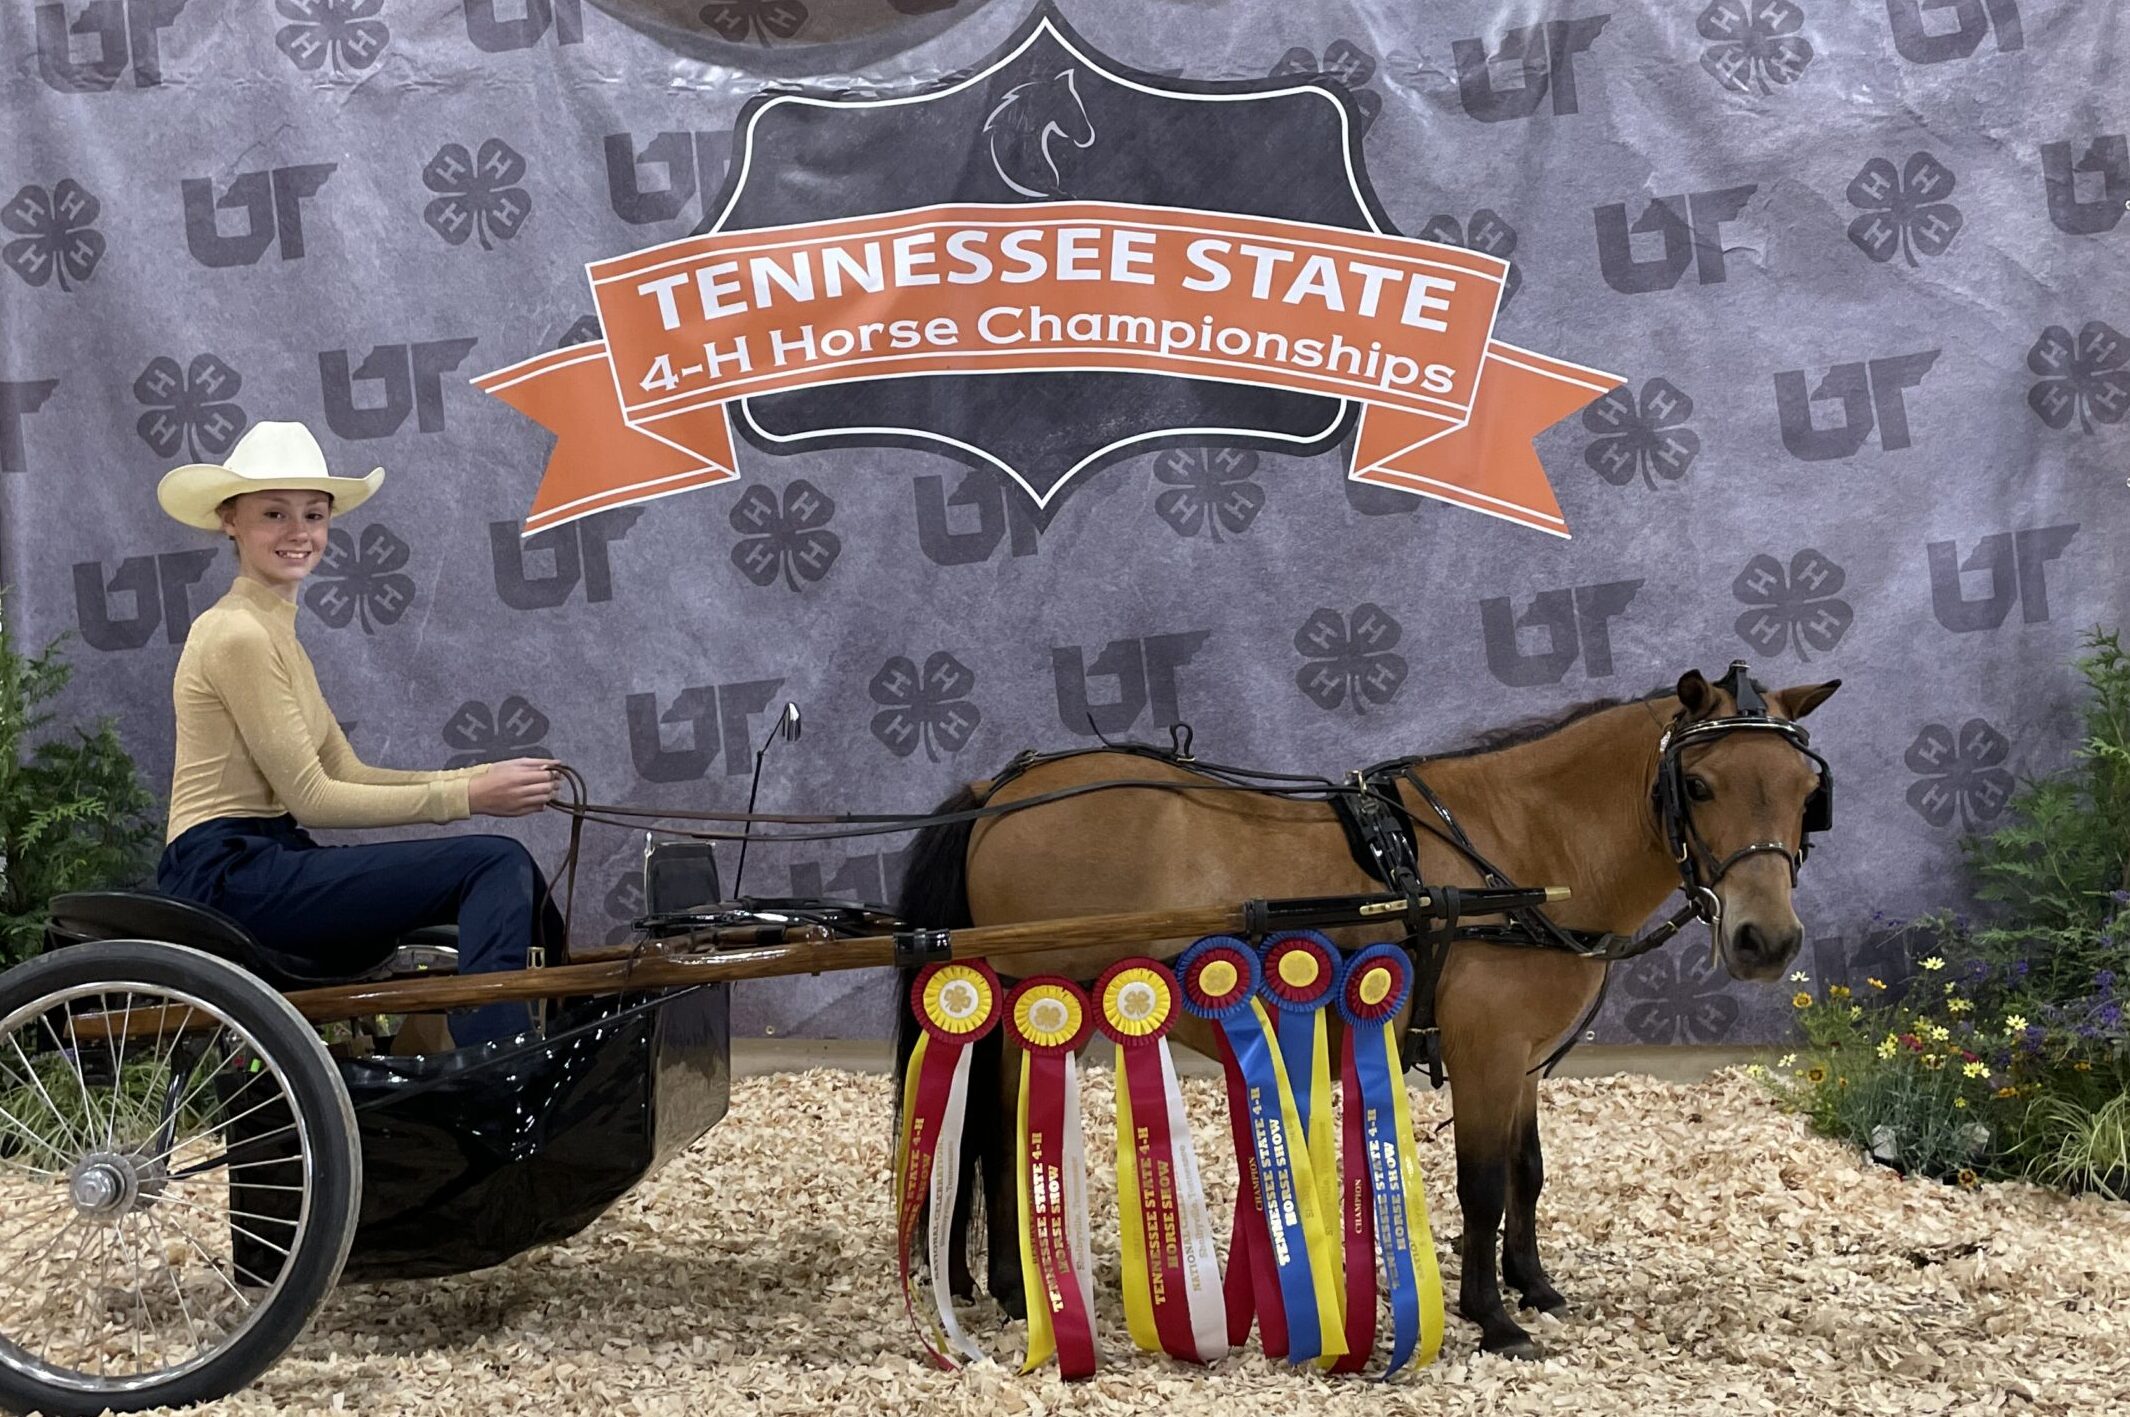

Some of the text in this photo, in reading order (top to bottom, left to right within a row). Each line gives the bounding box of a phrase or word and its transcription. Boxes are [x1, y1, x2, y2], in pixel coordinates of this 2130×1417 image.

[637, 228, 1458, 332] TENNESSEE STATE
[638, 305, 1457, 394] 4-H Horse Championships
[906, 1118, 924, 1200] STATE 4-H
[1031, 1131, 1043, 1160] 4-H
[1032, 1162, 1046, 1214] STATE
[1248, 1156, 1263, 1211] CHAMPION
[1250, 1087, 1290, 1266] TENNESSEE STATE 4-H
[1269, 1118, 1298, 1226] HORSE SHOW
[1048, 1165, 1070, 1274] HORSE SHOW
[1137, 1127, 1166, 1305] TENNESSEE STATE 4-H
[1158, 1160, 1179, 1269] HORSE SHOW
[1354, 1179, 1362, 1234] CHAMPION
[1367, 1109, 1400, 1290] TENNESSEE STATE 4-H
[1384, 1141, 1406, 1250] HORSE SHOW
[1037, 1217, 1064, 1312] TENNESSEE
[1184, 1230, 1201, 1291] NATIONAL
